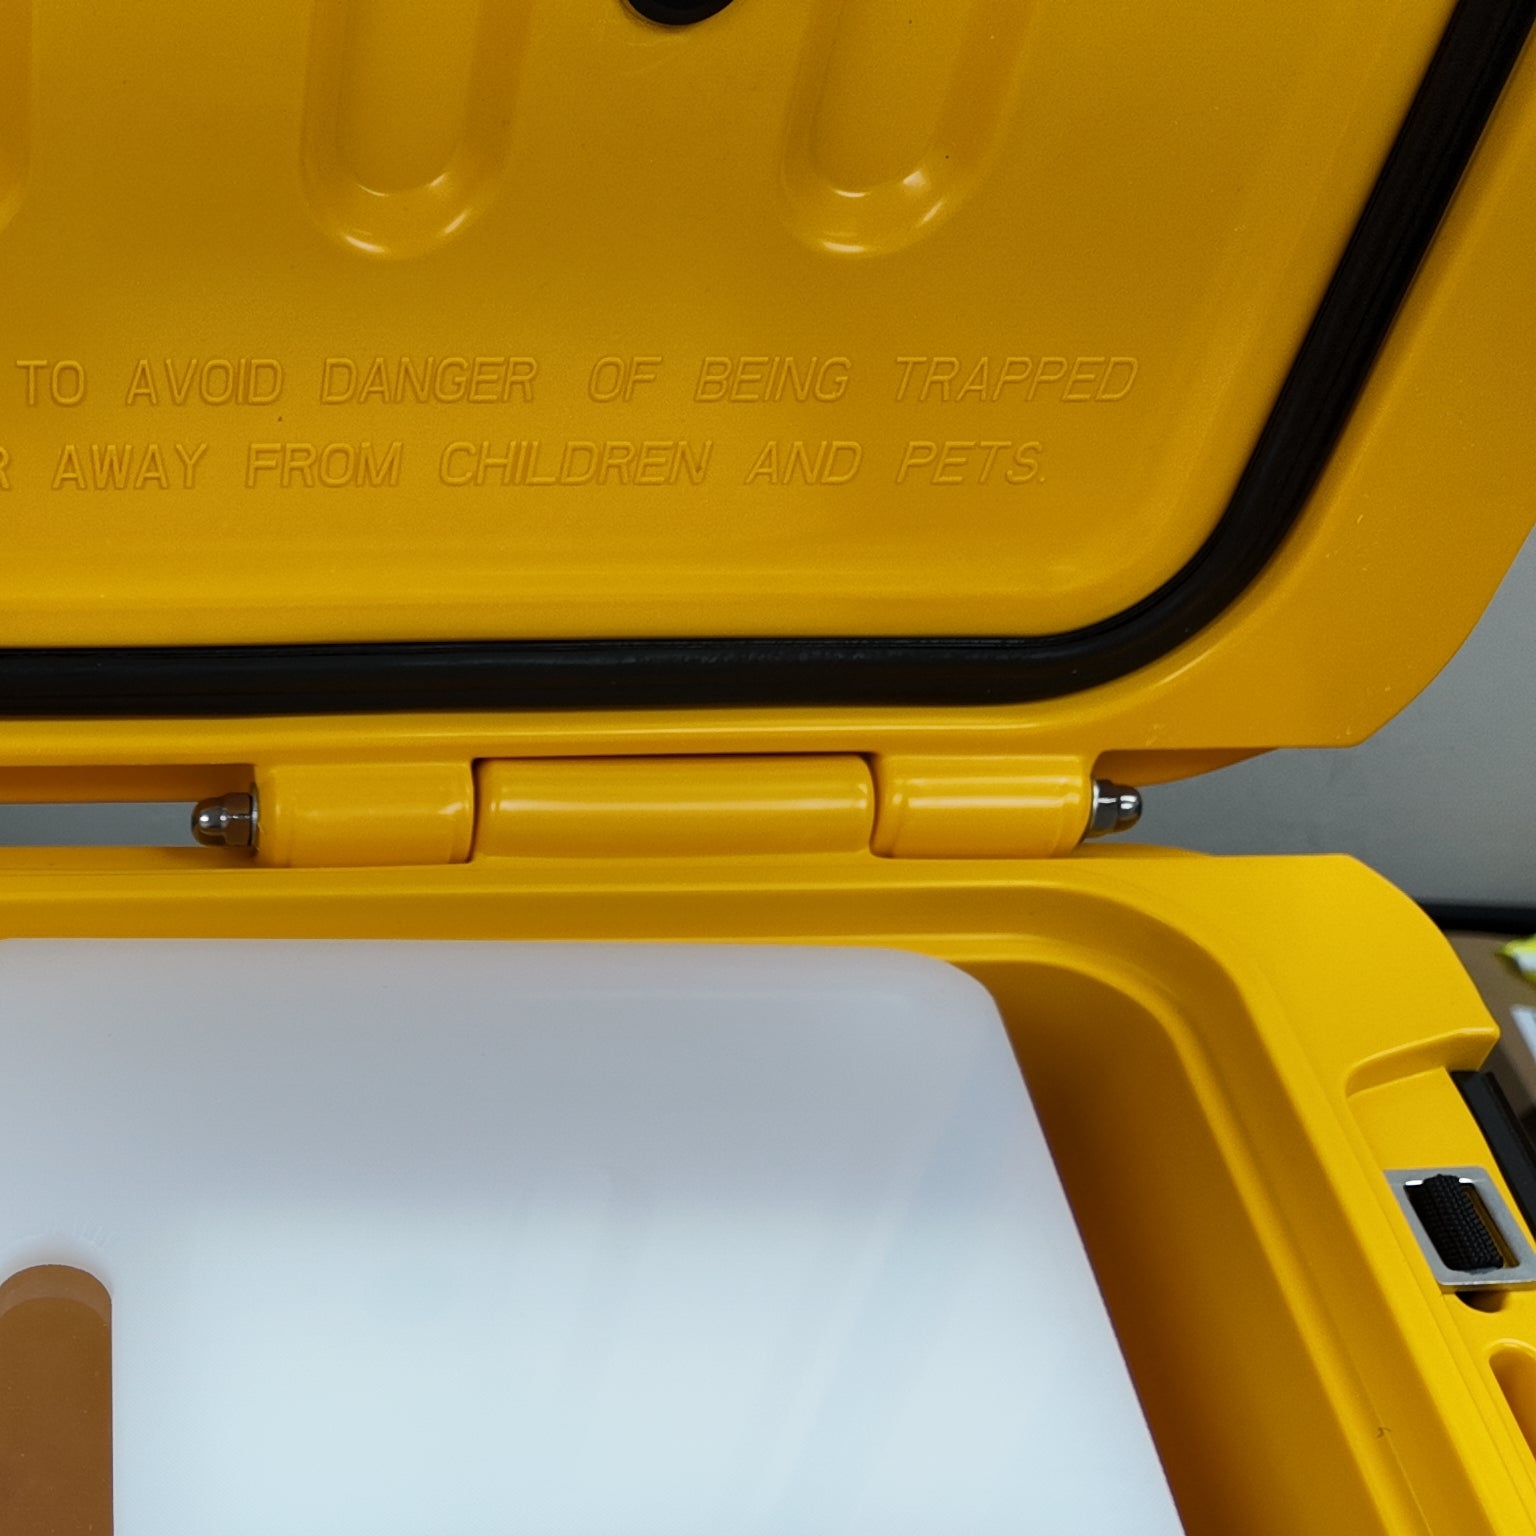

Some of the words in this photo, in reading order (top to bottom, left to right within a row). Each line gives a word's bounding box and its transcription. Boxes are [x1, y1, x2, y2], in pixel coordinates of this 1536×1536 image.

[15, 358, 88, 406] TO
[125, 356, 285, 406] AVOID
[319, 354, 539, 404] DANGER
[587, 354, 663, 403] OF
[694, 354, 853, 403] BEING
[895, 354, 1140, 403] TRAPPED
[51, 442, 209, 490] AWAY
[244, 441, 404, 489] FROM
[437, 439, 713, 488] CHILDREN
[743, 439, 864, 487] AND
[895, 439, 1048, 487] PETS.
